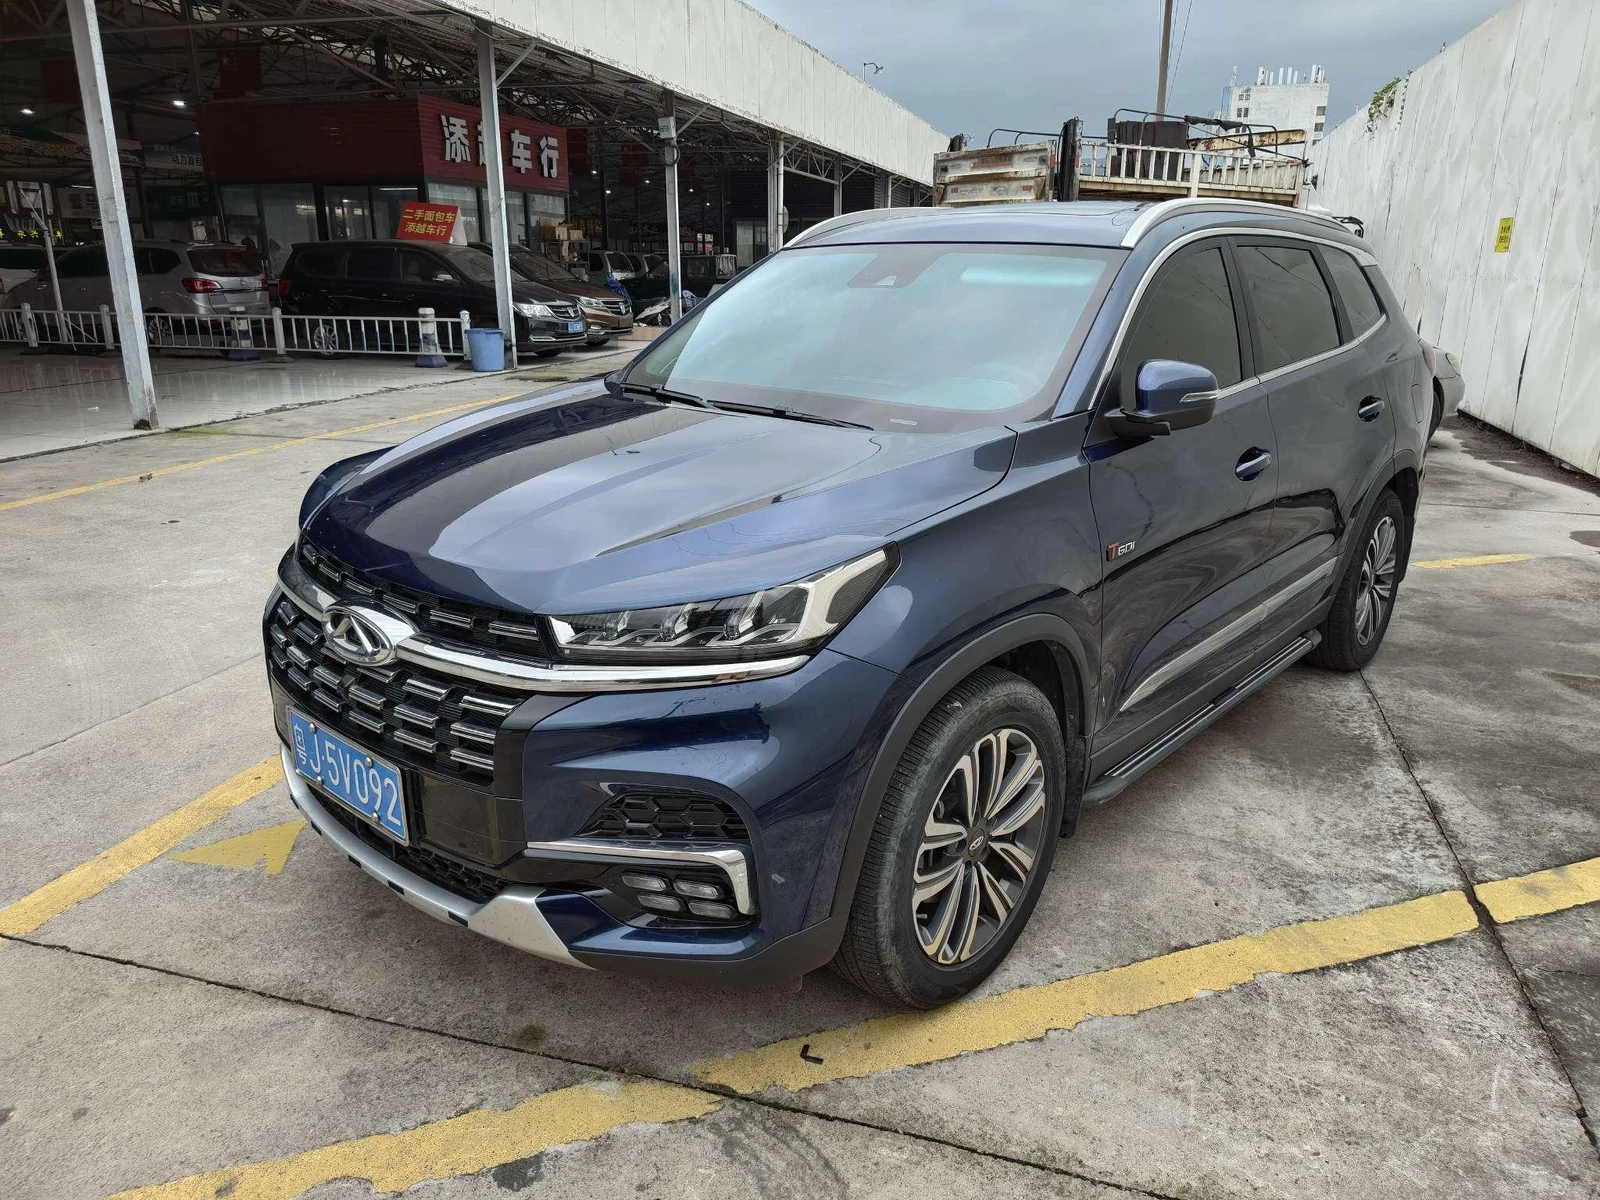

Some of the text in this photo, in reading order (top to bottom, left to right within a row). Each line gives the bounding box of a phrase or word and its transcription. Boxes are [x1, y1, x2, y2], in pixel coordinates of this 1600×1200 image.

[440, 114, 560, 178] 添车行
[402, 208, 456, 223] 二手面包车
[404, 222, 448, 236] 添越车行
